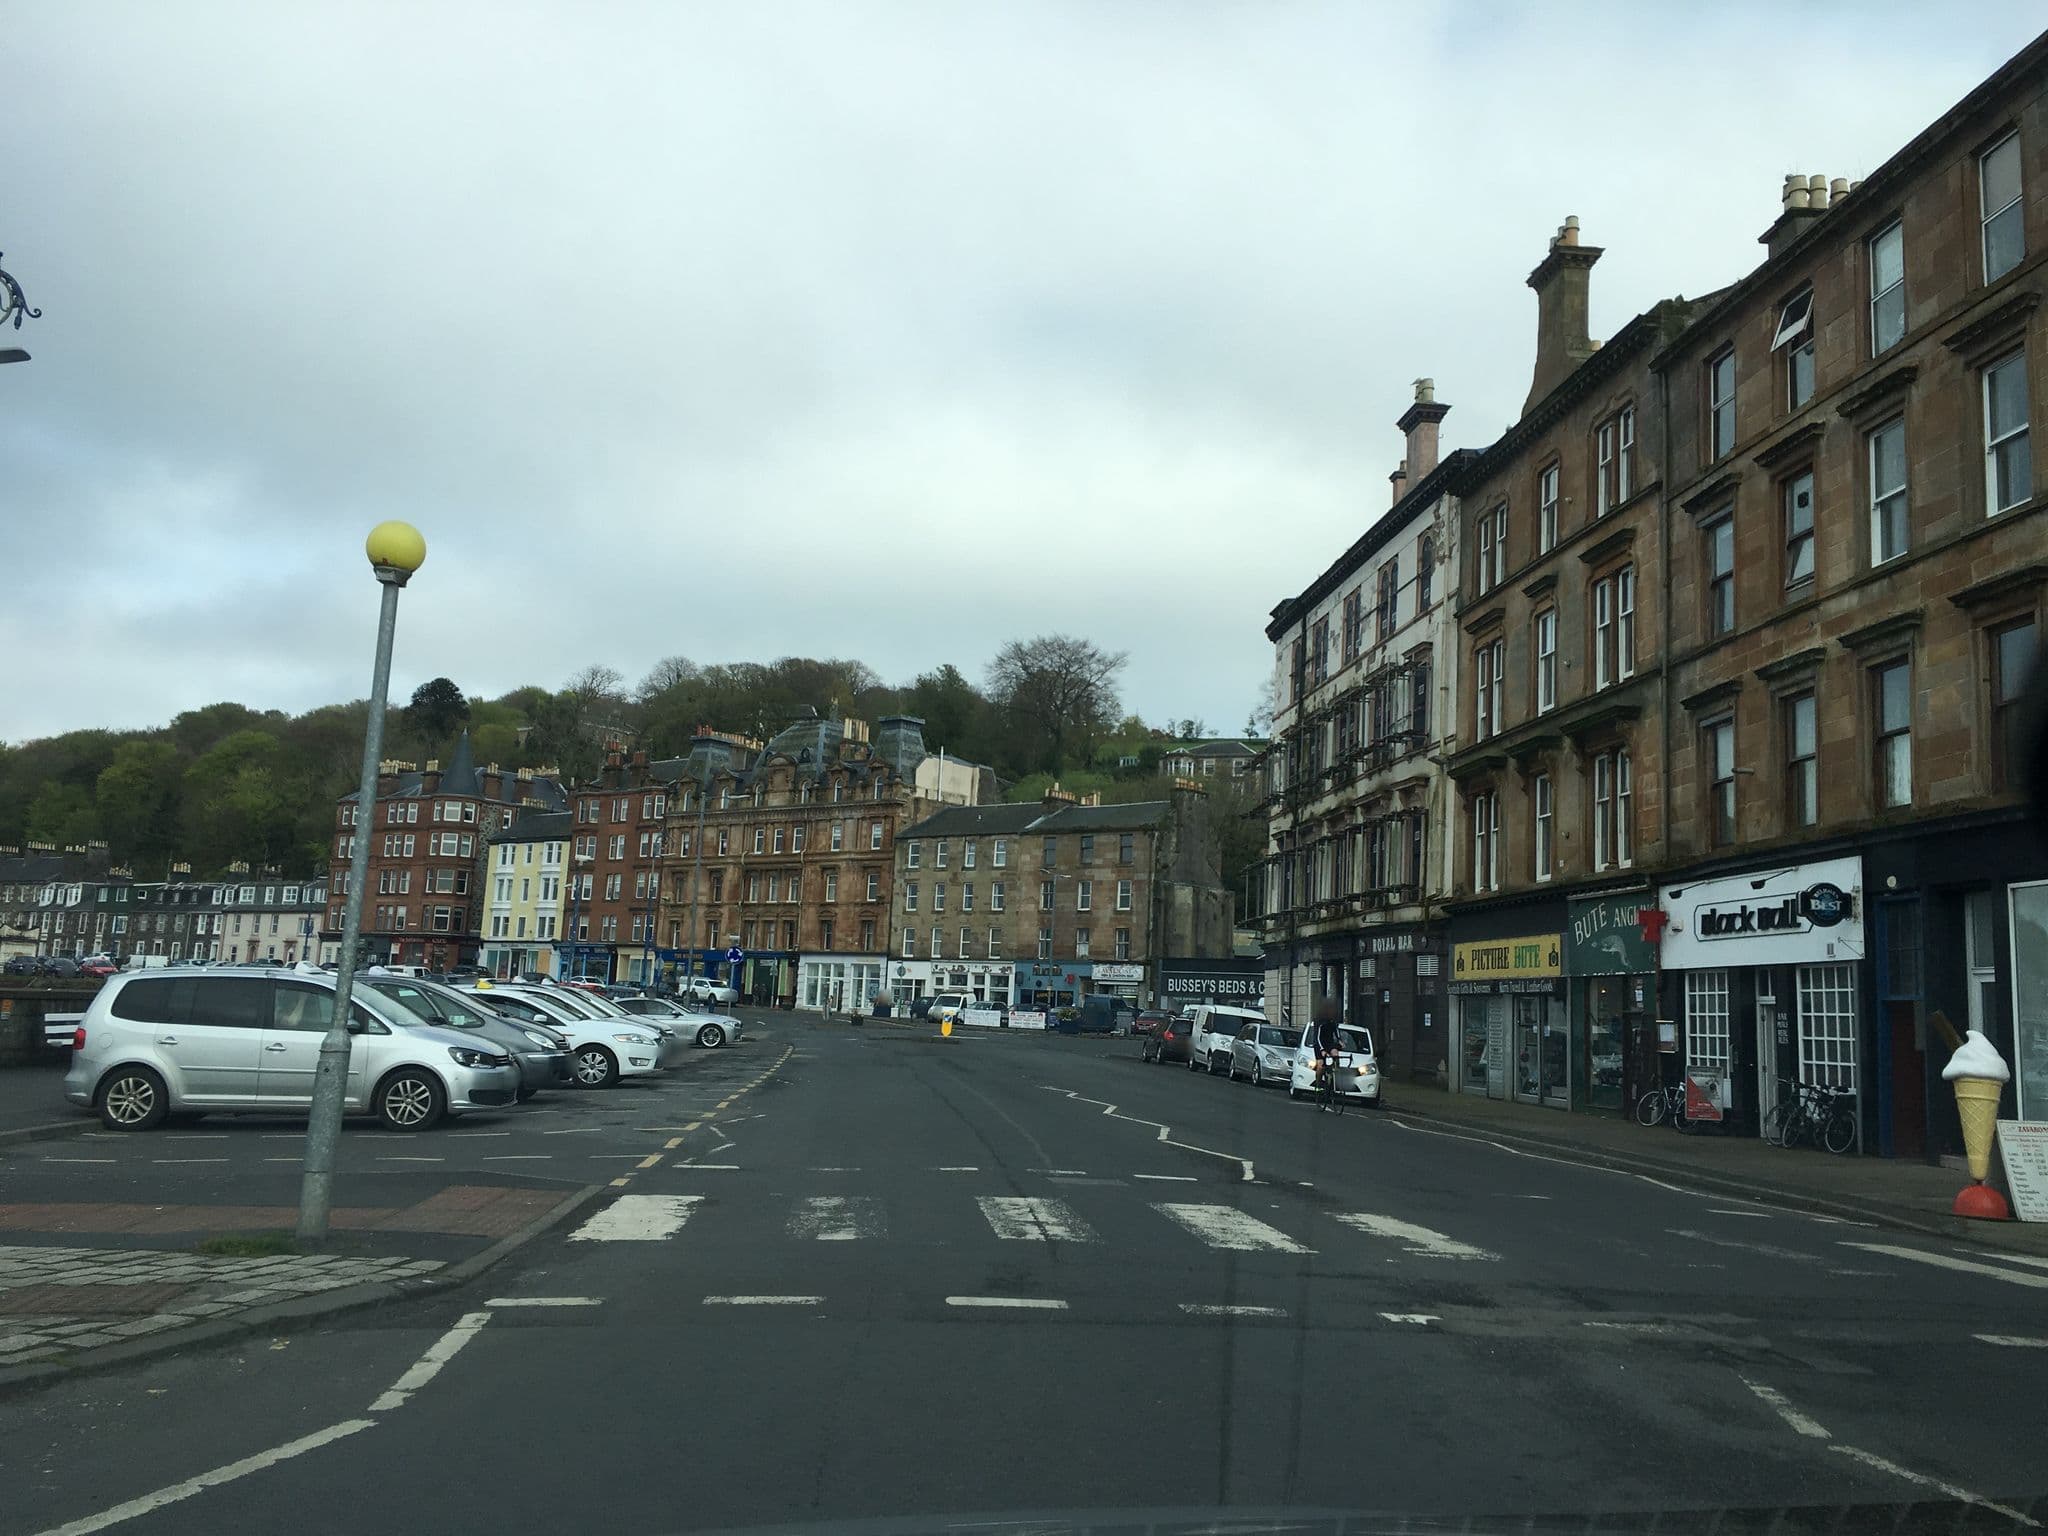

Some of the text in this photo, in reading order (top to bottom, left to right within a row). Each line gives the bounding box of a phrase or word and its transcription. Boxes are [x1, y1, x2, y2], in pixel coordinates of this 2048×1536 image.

[1810, 899, 1842, 911] BEST
[1575, 902, 1607, 946] BUTE
[1372, 935, 1414, 953] ROYAL BAR
[1471, 945, 1541, 971] PICTURE BUTE
[1168, 979, 1216, 993] BUSSEY'S
[1218, 980, 1246, 994] BEDS
[1248, 981, 1256, 994] &
